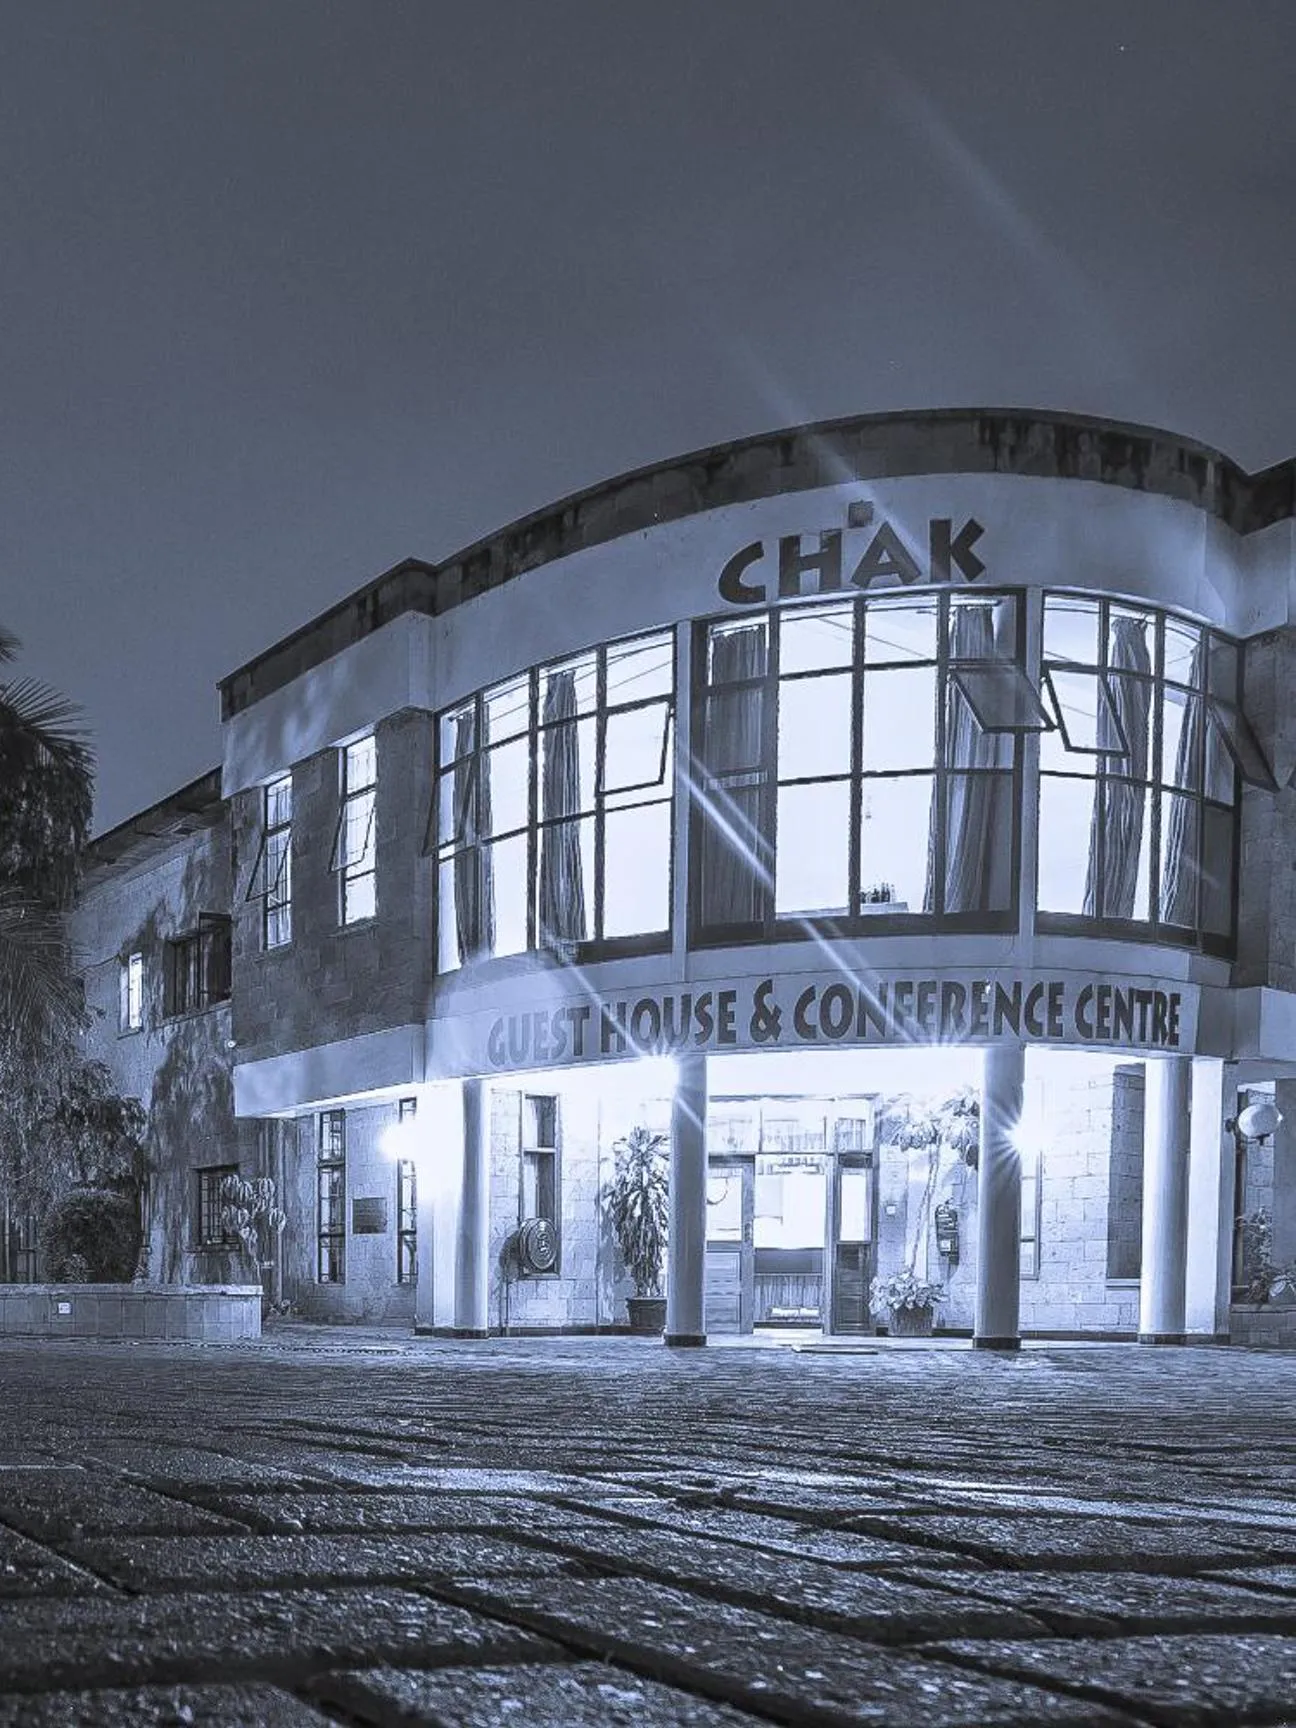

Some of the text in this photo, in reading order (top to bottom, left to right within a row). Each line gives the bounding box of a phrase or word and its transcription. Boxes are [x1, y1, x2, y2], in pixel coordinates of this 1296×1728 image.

[718, 518, 987, 604] CHAK
[487, 978, 1181, 1068] GUEST HOUSE & CONFERENCE CENTRE
